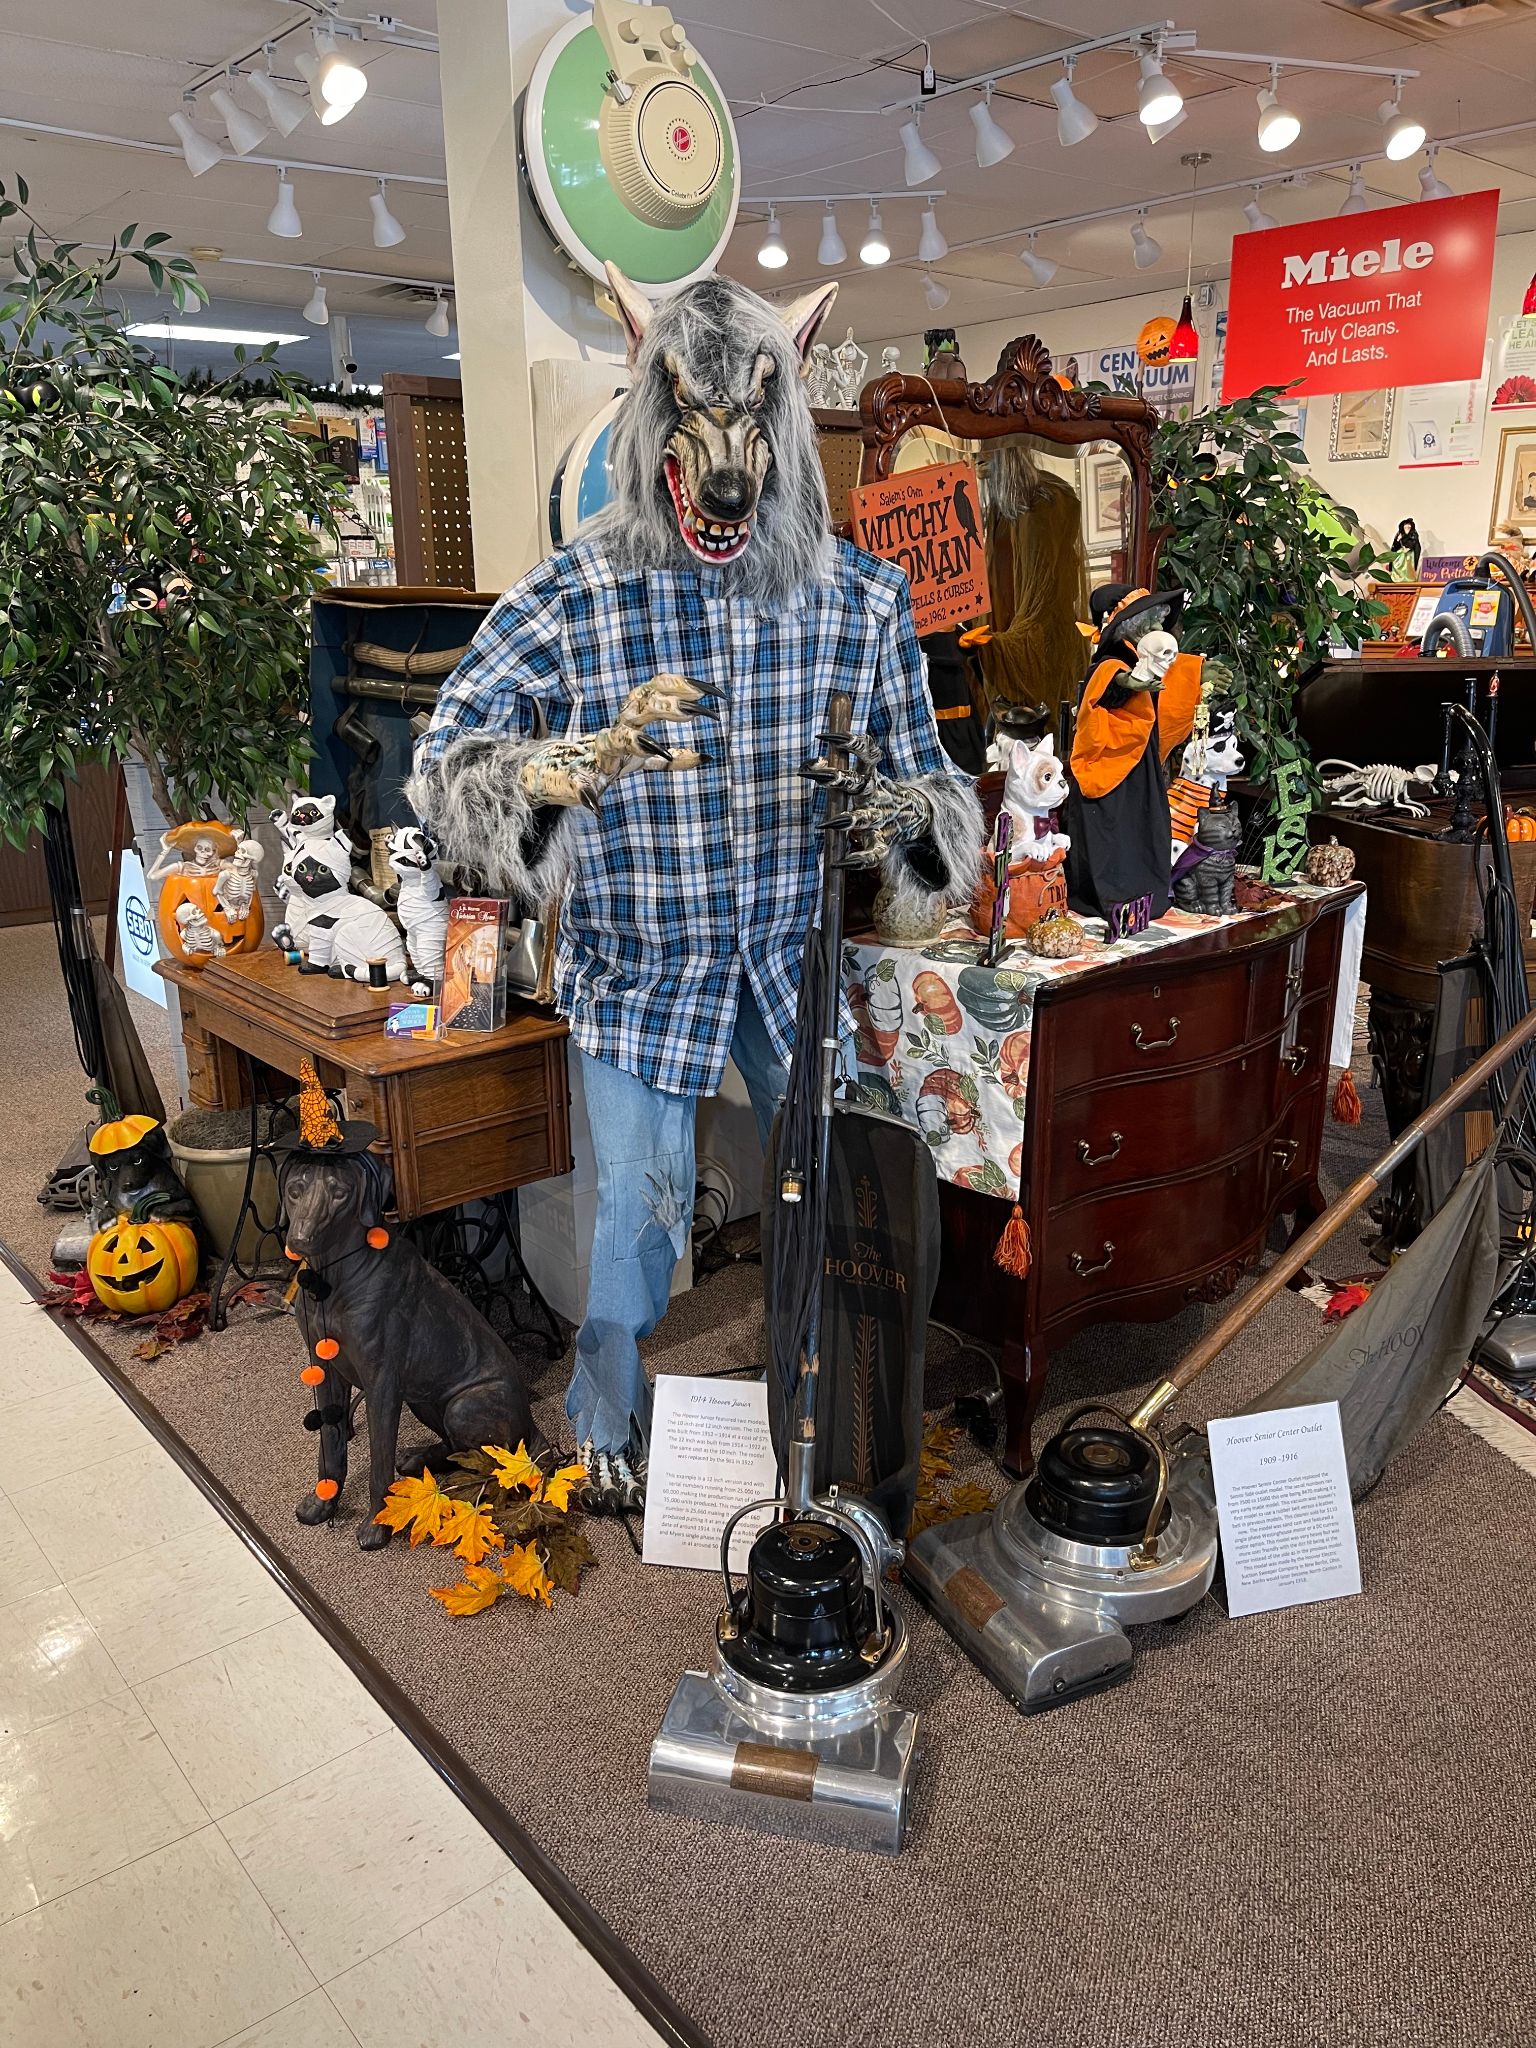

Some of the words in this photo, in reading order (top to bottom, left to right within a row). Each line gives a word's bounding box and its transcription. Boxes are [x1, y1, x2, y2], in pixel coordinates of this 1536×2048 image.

[1280, 238, 1434, 290] Miele
[1286, 306, 1314, 324] The
[1318, 299, 1380, 319] Vacuum
[1386, 290, 1422, 310] That
[1301, 327, 1337, 346] Truly
[1341, 320, 1400, 339] Cleans.
[1502, 328, 1536, 340] CLEA
[1306, 350, 1337, 367] And
[1342, 344, 1388, 364] Lasts.
[879, 488, 906, 506] Salem's
[907, 485, 924, 498] Own
[859, 496, 952, 552] WITCHY
[886, 535, 972, 586] OMAN
[911, 594, 936, 610] PELLS
[937, 592, 943, 603] &
[944, 579, 974, 601] CURSES
[915, 616, 929, 630] ince
[929, 608, 947, 624] 1962
[127, 912, 152, 942] SEBO
[854, 1241, 882, 1262] The
[824, 1257, 907, 1294] HOOVER
[708, 1397, 730, 1406] Hoover
[731, 1399, 750, 1408] Junior
[1226, 1434, 1253, 1447] Hoover
[1254, 1431, 1276, 1442] Senior
[1276, 1428, 1299, 1439] Center
[1300, 1423, 1323, 1434] Outlet
[1259, 1456, 1277, 1466] 1909
